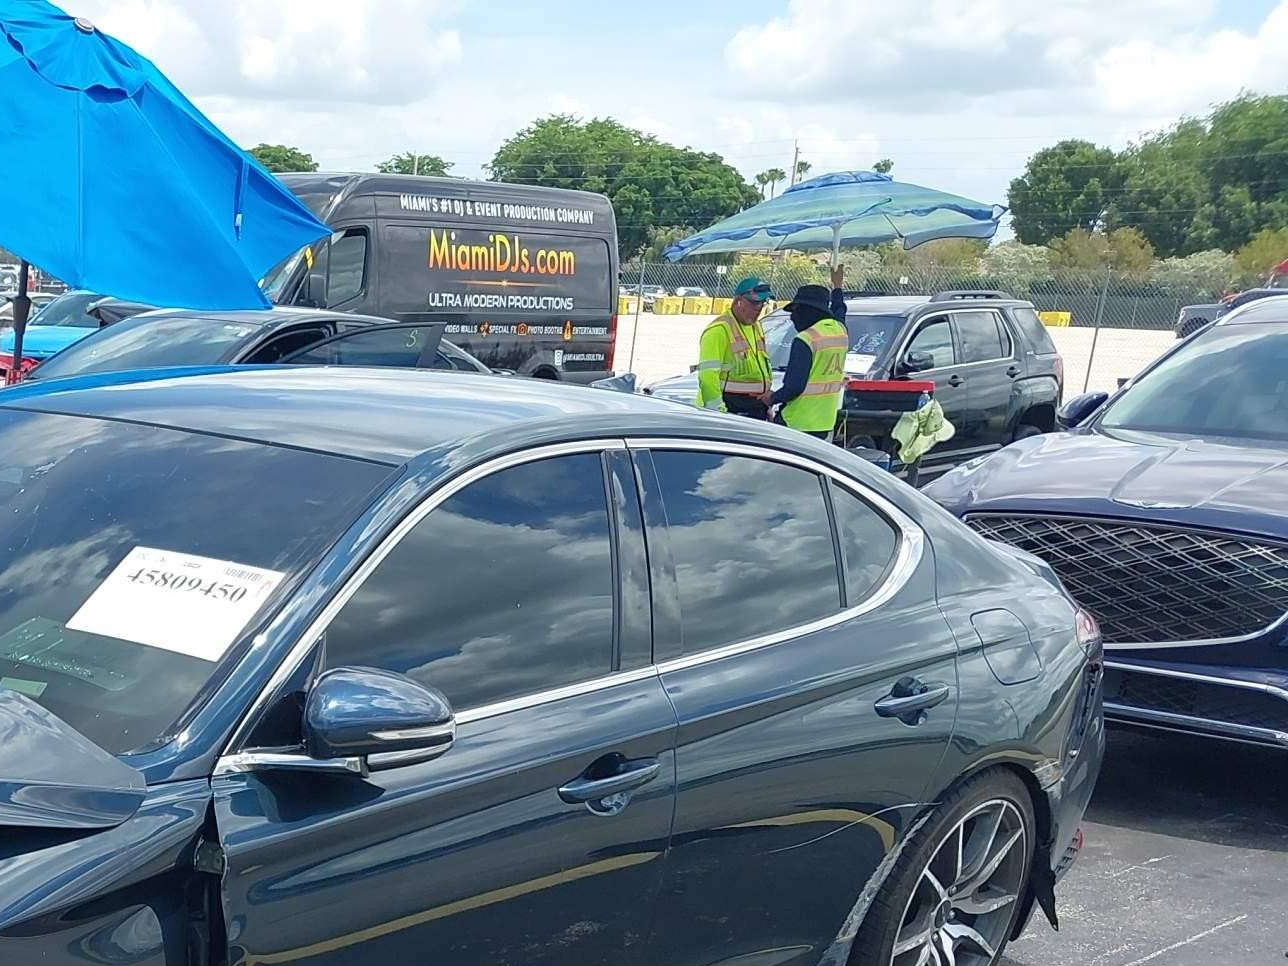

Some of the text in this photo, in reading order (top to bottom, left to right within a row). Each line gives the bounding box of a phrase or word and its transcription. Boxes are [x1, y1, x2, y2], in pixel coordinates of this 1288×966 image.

[400, 194, 594, 225] MIAMI'S #1 DJ & EVENT PRODUCTION COMPANY
[428, 228, 575, 275] MiamiDJs.com
[429, 292, 574, 310] ULTRA MODERN PRODUCTIONS
[488, 325, 510, 334] SPECIAL
[127, 568, 248, 602] 45809450
